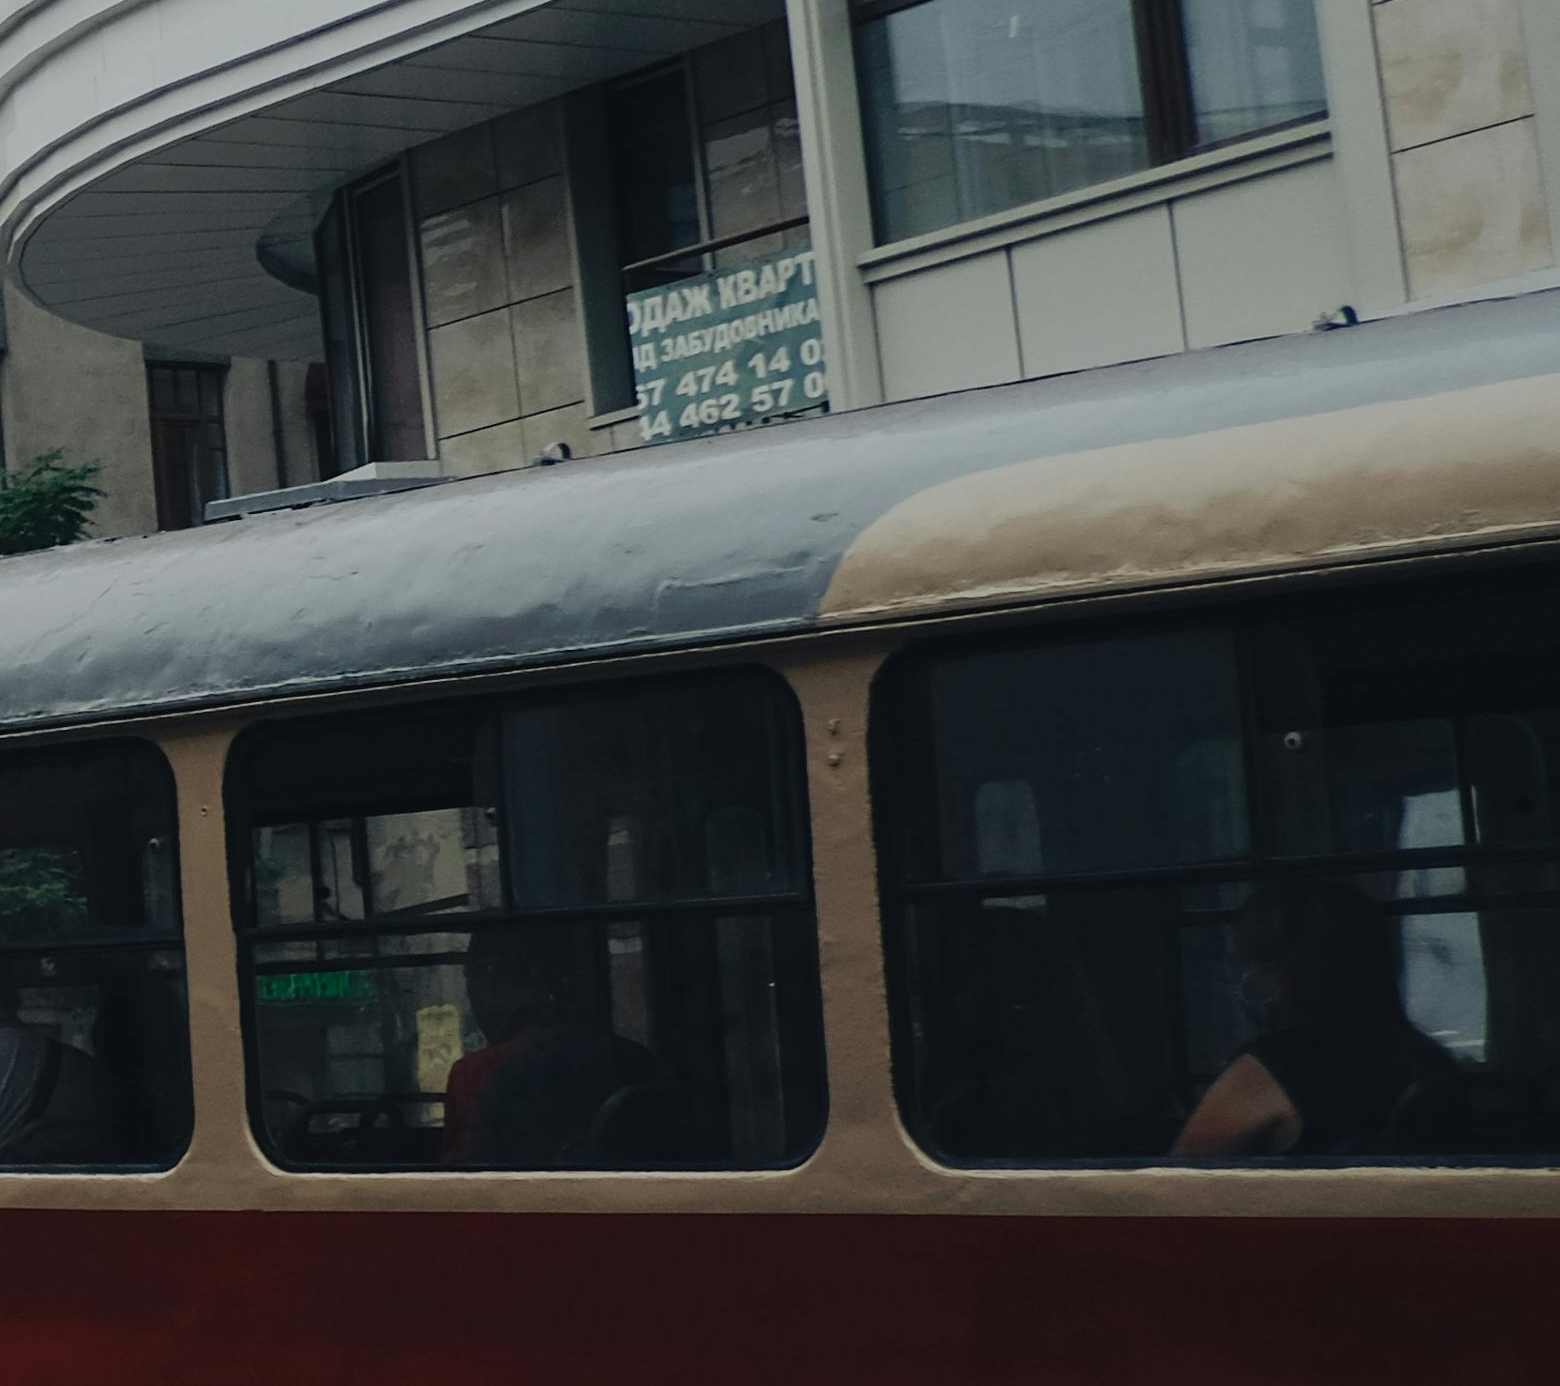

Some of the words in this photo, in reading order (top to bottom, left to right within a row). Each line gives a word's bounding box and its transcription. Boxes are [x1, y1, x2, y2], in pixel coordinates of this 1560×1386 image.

[717, 254, 817, 310] КВАРТ
[661, 298, 820, 362] ЗАБУДОВНИКА
[676, 360, 739, 397] 474
[748, 347, 791, 379] 14
[679, 394, 741, 428] 462
[751, 378, 794, 412] 57
